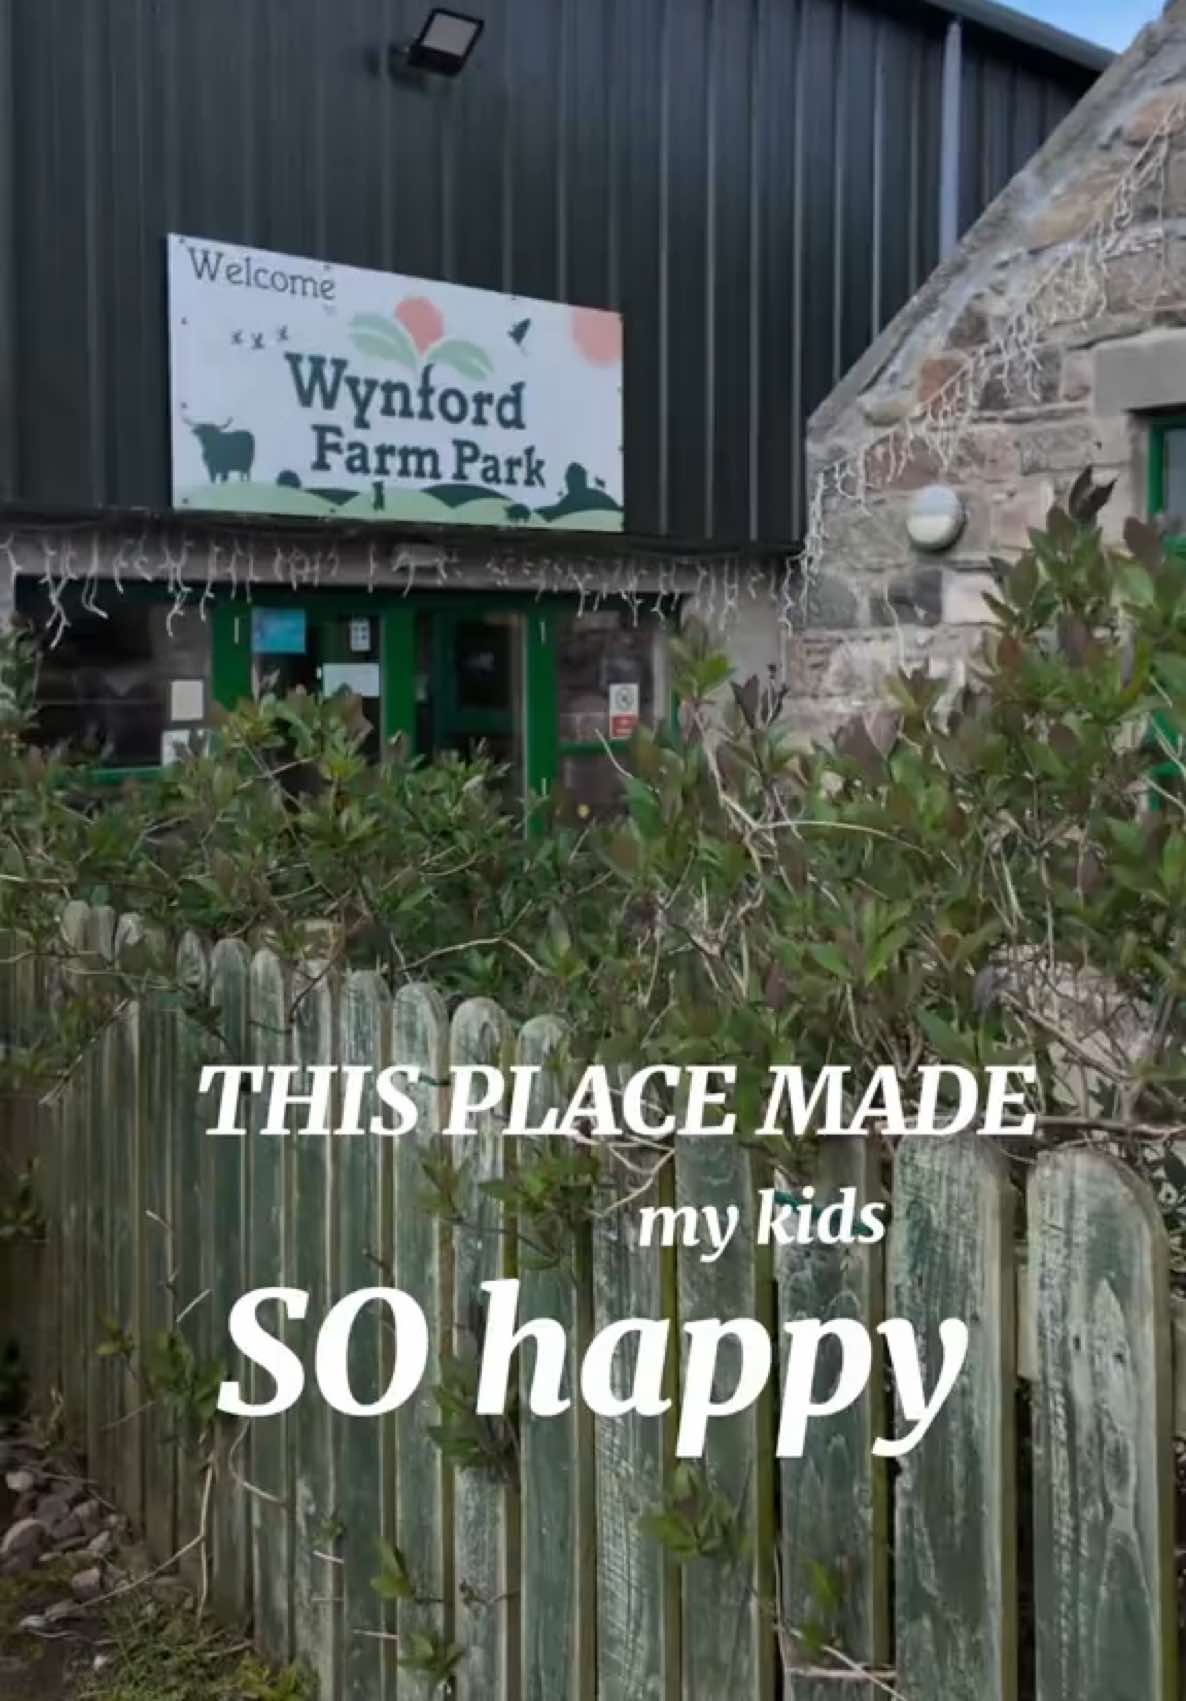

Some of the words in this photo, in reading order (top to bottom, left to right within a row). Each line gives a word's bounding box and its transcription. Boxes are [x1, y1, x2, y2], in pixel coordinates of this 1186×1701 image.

[187, 245, 336, 300] Welcome
[284, 351, 527, 430] Wynford
[311, 424, 440, 480] Farm
[452, 439, 546, 488] Park
